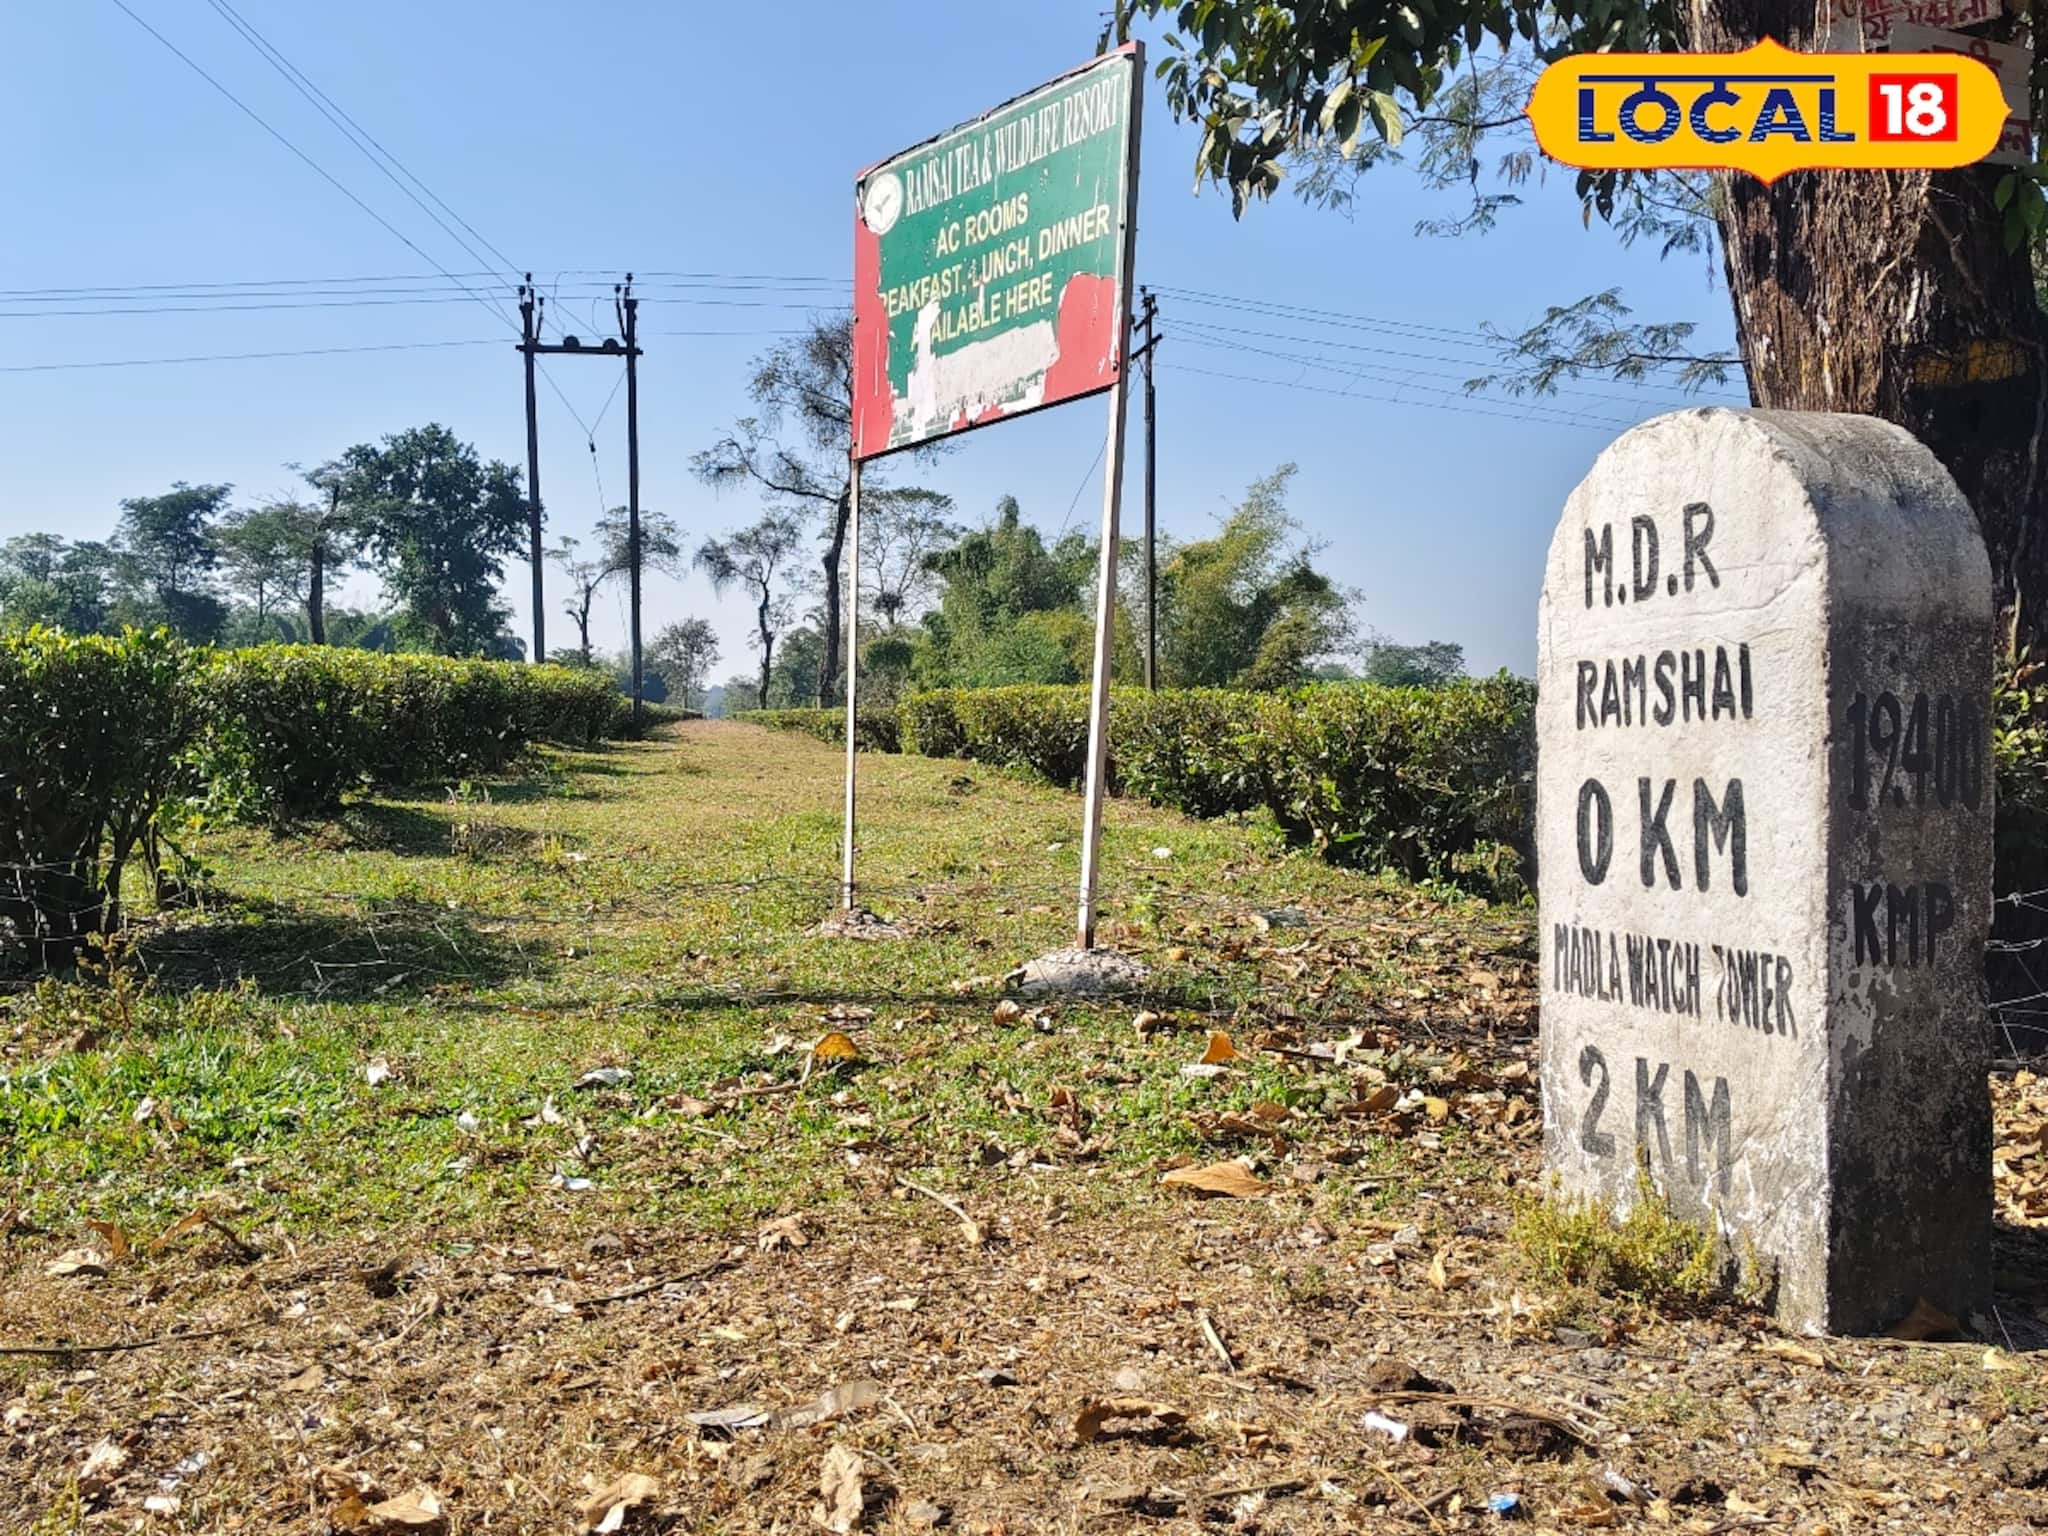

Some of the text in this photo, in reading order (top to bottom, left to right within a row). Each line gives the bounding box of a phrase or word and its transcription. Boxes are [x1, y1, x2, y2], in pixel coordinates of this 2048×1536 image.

[906, 74, 1121, 217] RAMSAI TEA & WILDLIFE RESORT
[936, 192, 1029, 258] AC ROOMS
[1039, 203, 1111, 261] DINNER
[1006, 272, 1053, 318] HERE
[1584, 502, 1720, 610] M.D.R
[1576, 642, 1753, 731] RAMSHAI
[1638, 777, 1749, 897] KM
[1852, 882, 1954, 968] KMP
[1626, 932, 1700, 1024] WATCH
[1712, 944, 1798, 1040] TOWER
[1579, 1044, 1732, 1198] 2 KM
